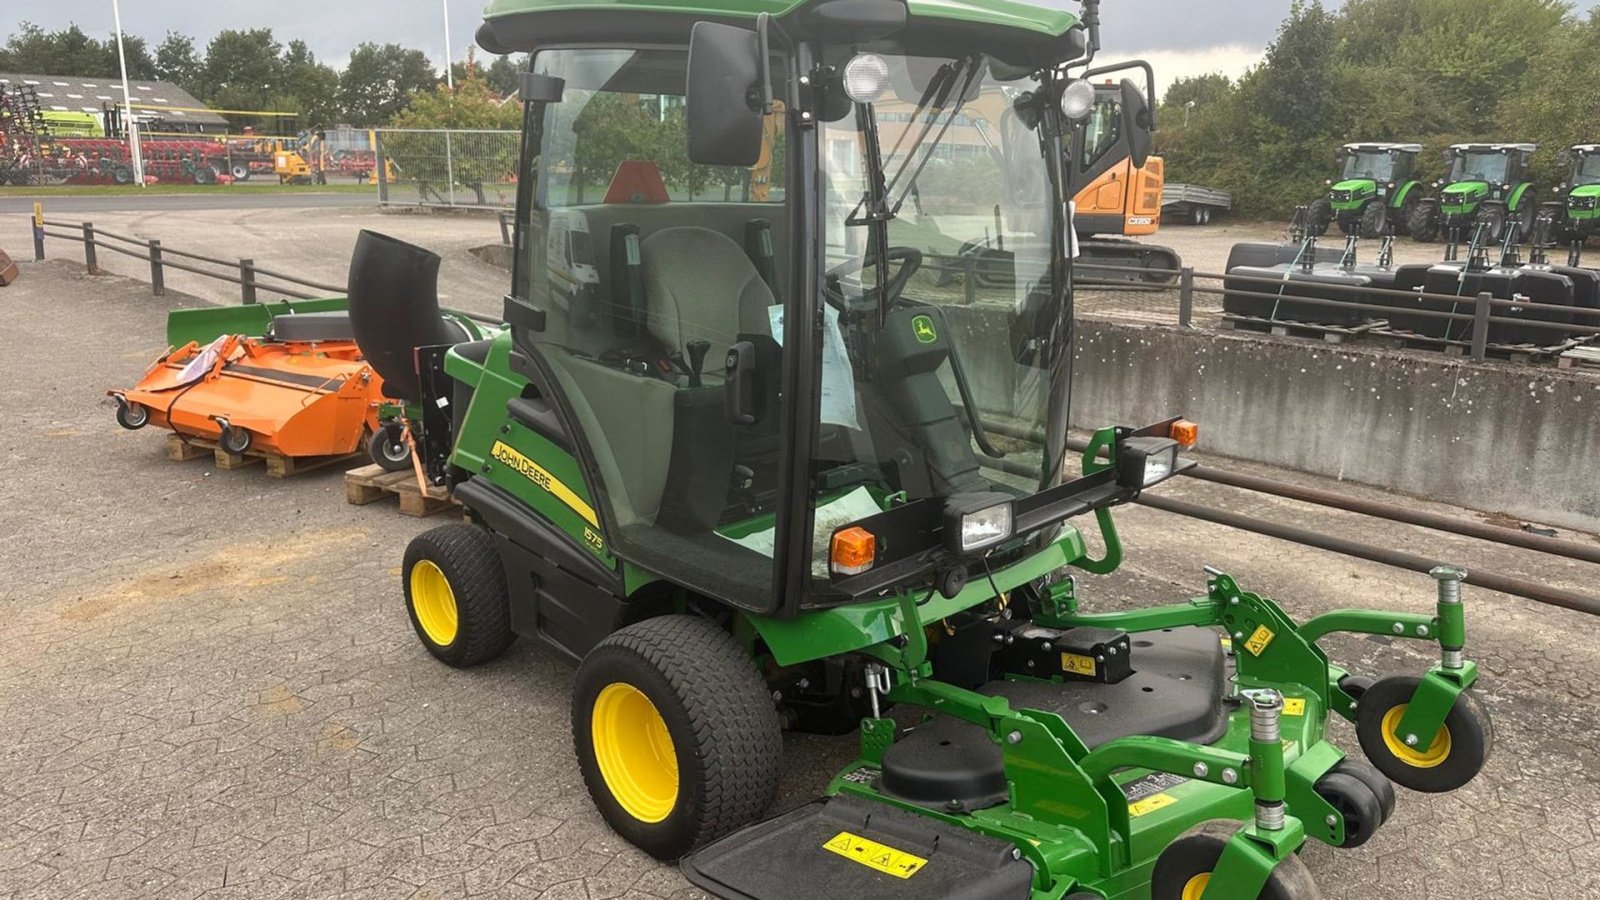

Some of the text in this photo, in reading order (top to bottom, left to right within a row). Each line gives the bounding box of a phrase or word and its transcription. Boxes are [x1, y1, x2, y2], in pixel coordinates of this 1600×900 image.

[495, 445, 551, 490] JOHN DEERE
[584, 526, 603, 549] 1575
